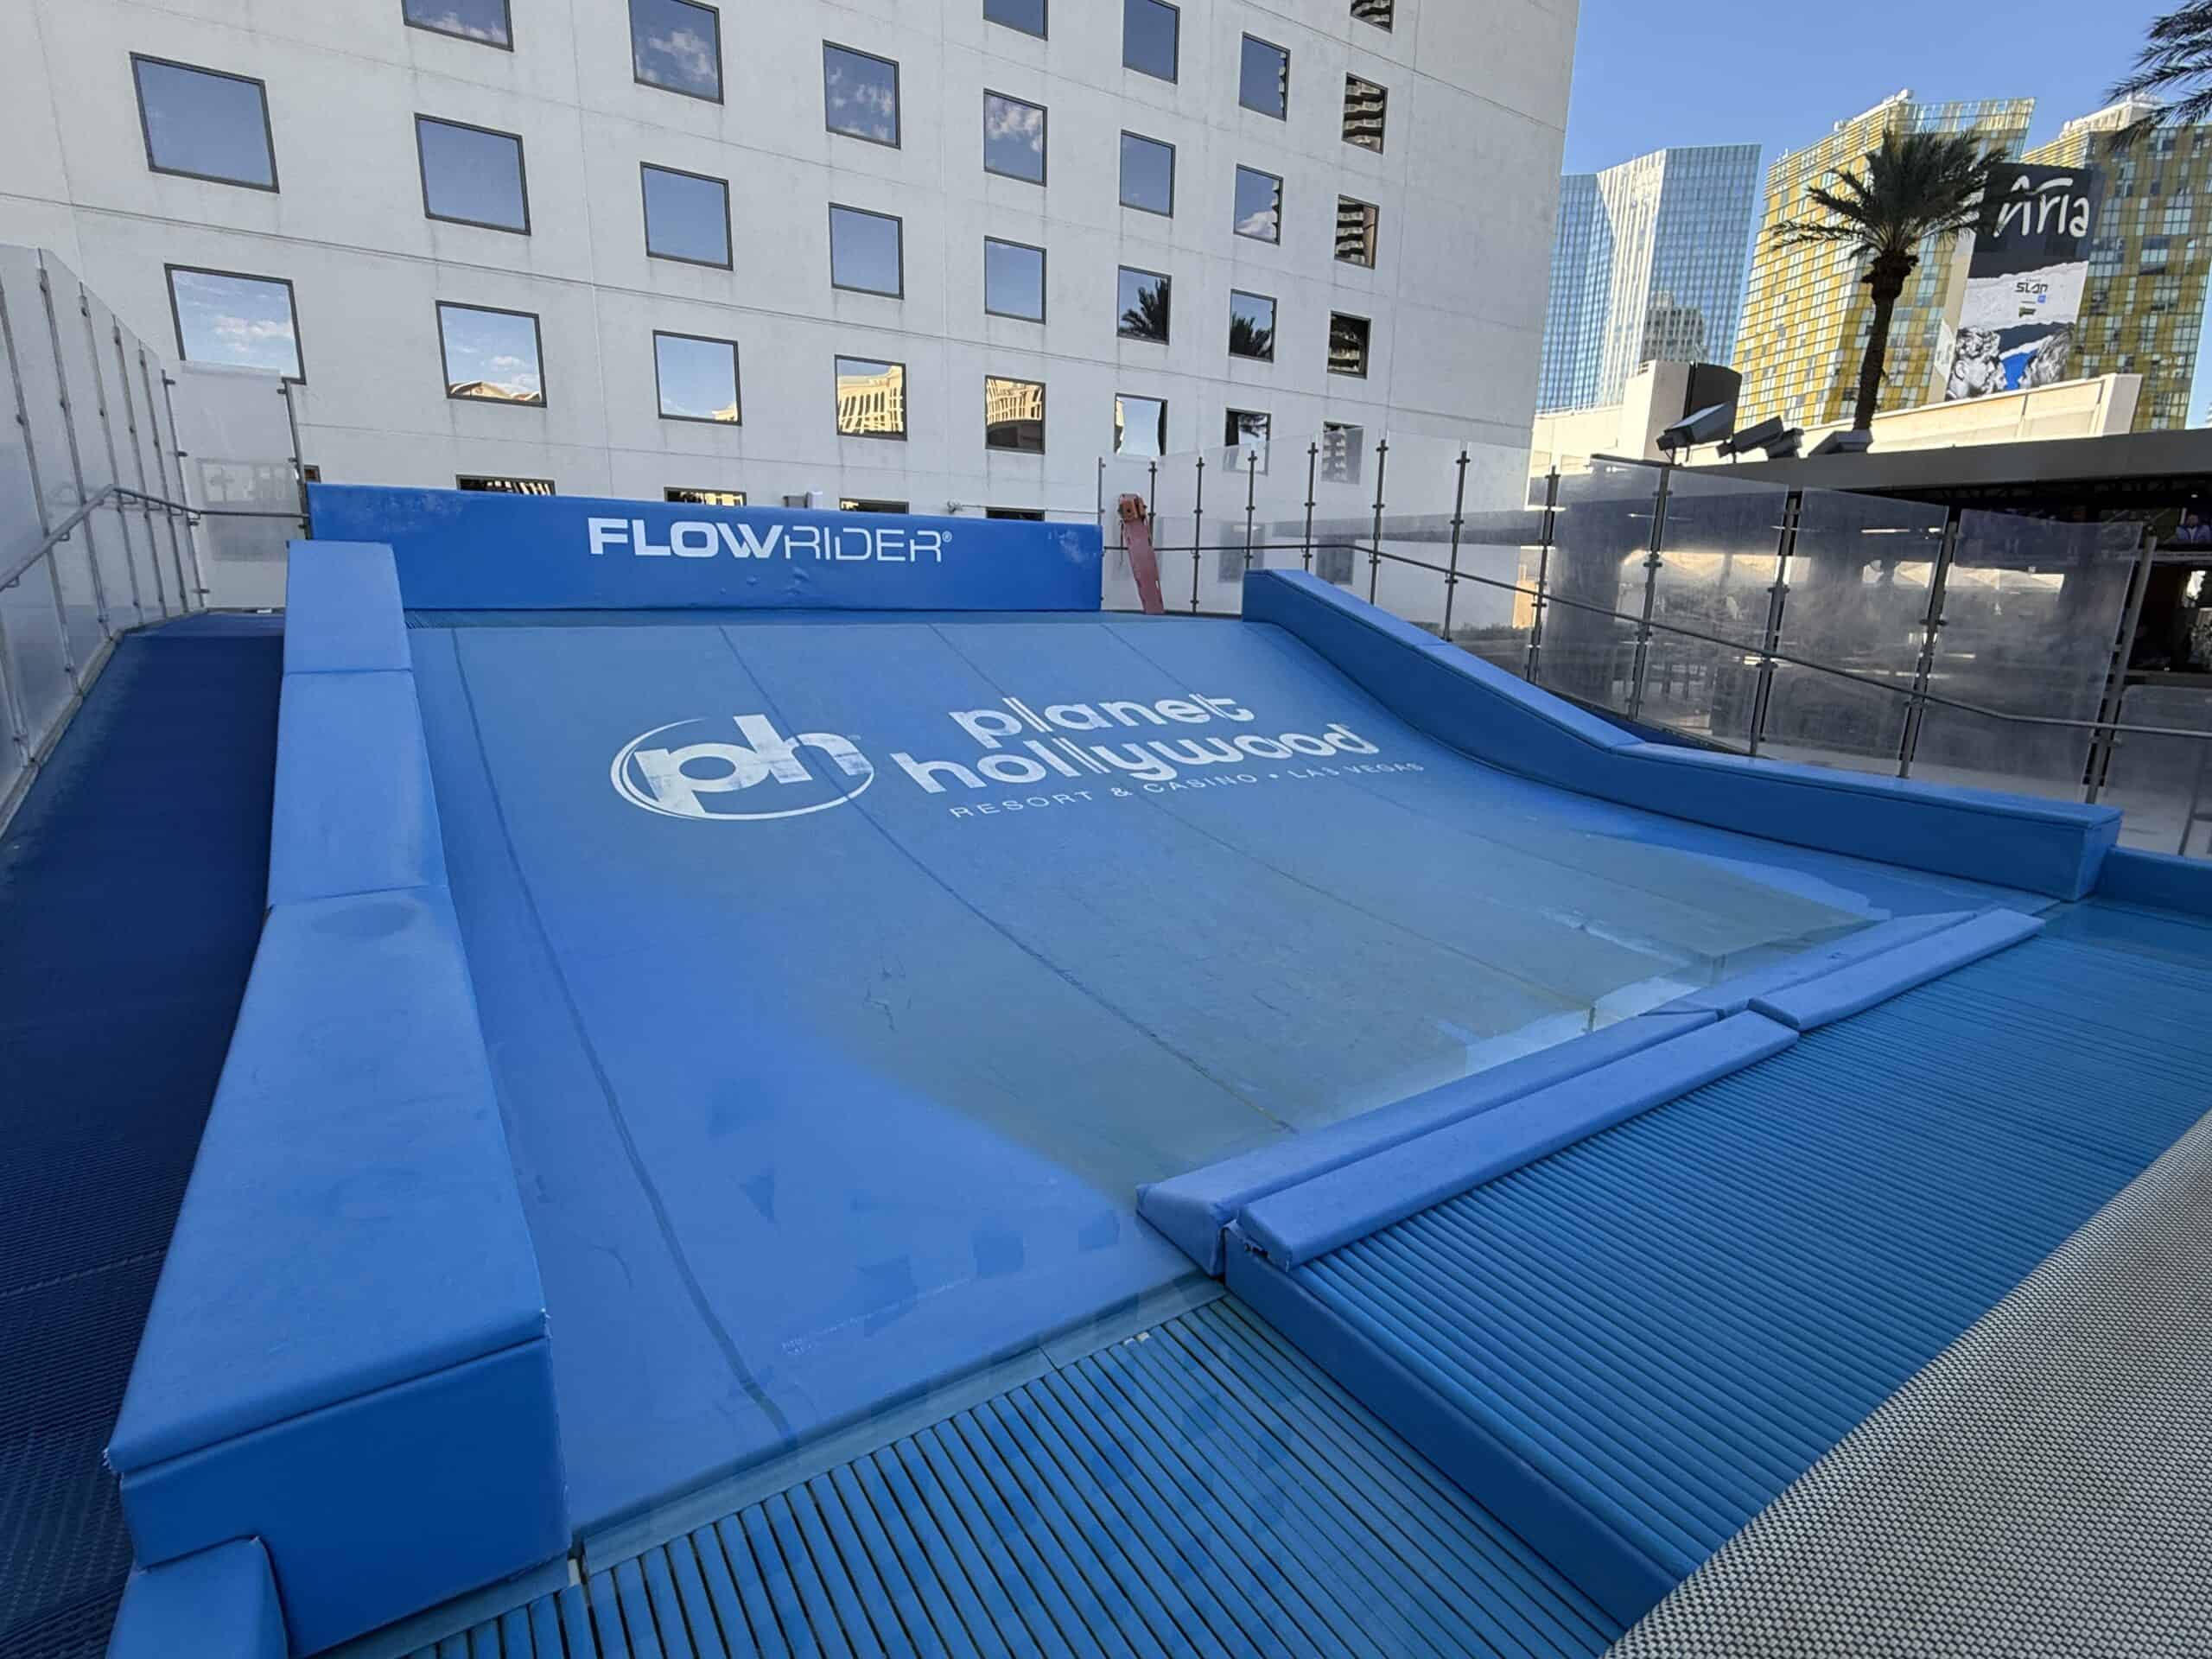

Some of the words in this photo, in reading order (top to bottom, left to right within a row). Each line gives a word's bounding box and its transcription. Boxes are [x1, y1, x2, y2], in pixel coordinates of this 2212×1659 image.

[949, 693, 1255, 748] planet
[633, 714, 874, 814] ph
[889, 722, 1380, 793] hollywood
[950, 790, 1093, 818] RESORT
[1110, 787, 1133, 798] &
[1143, 772, 1258, 793] CASINO
[1287, 766, 1340, 779] LAS
[1343, 762, 1425, 775] VEGAS
